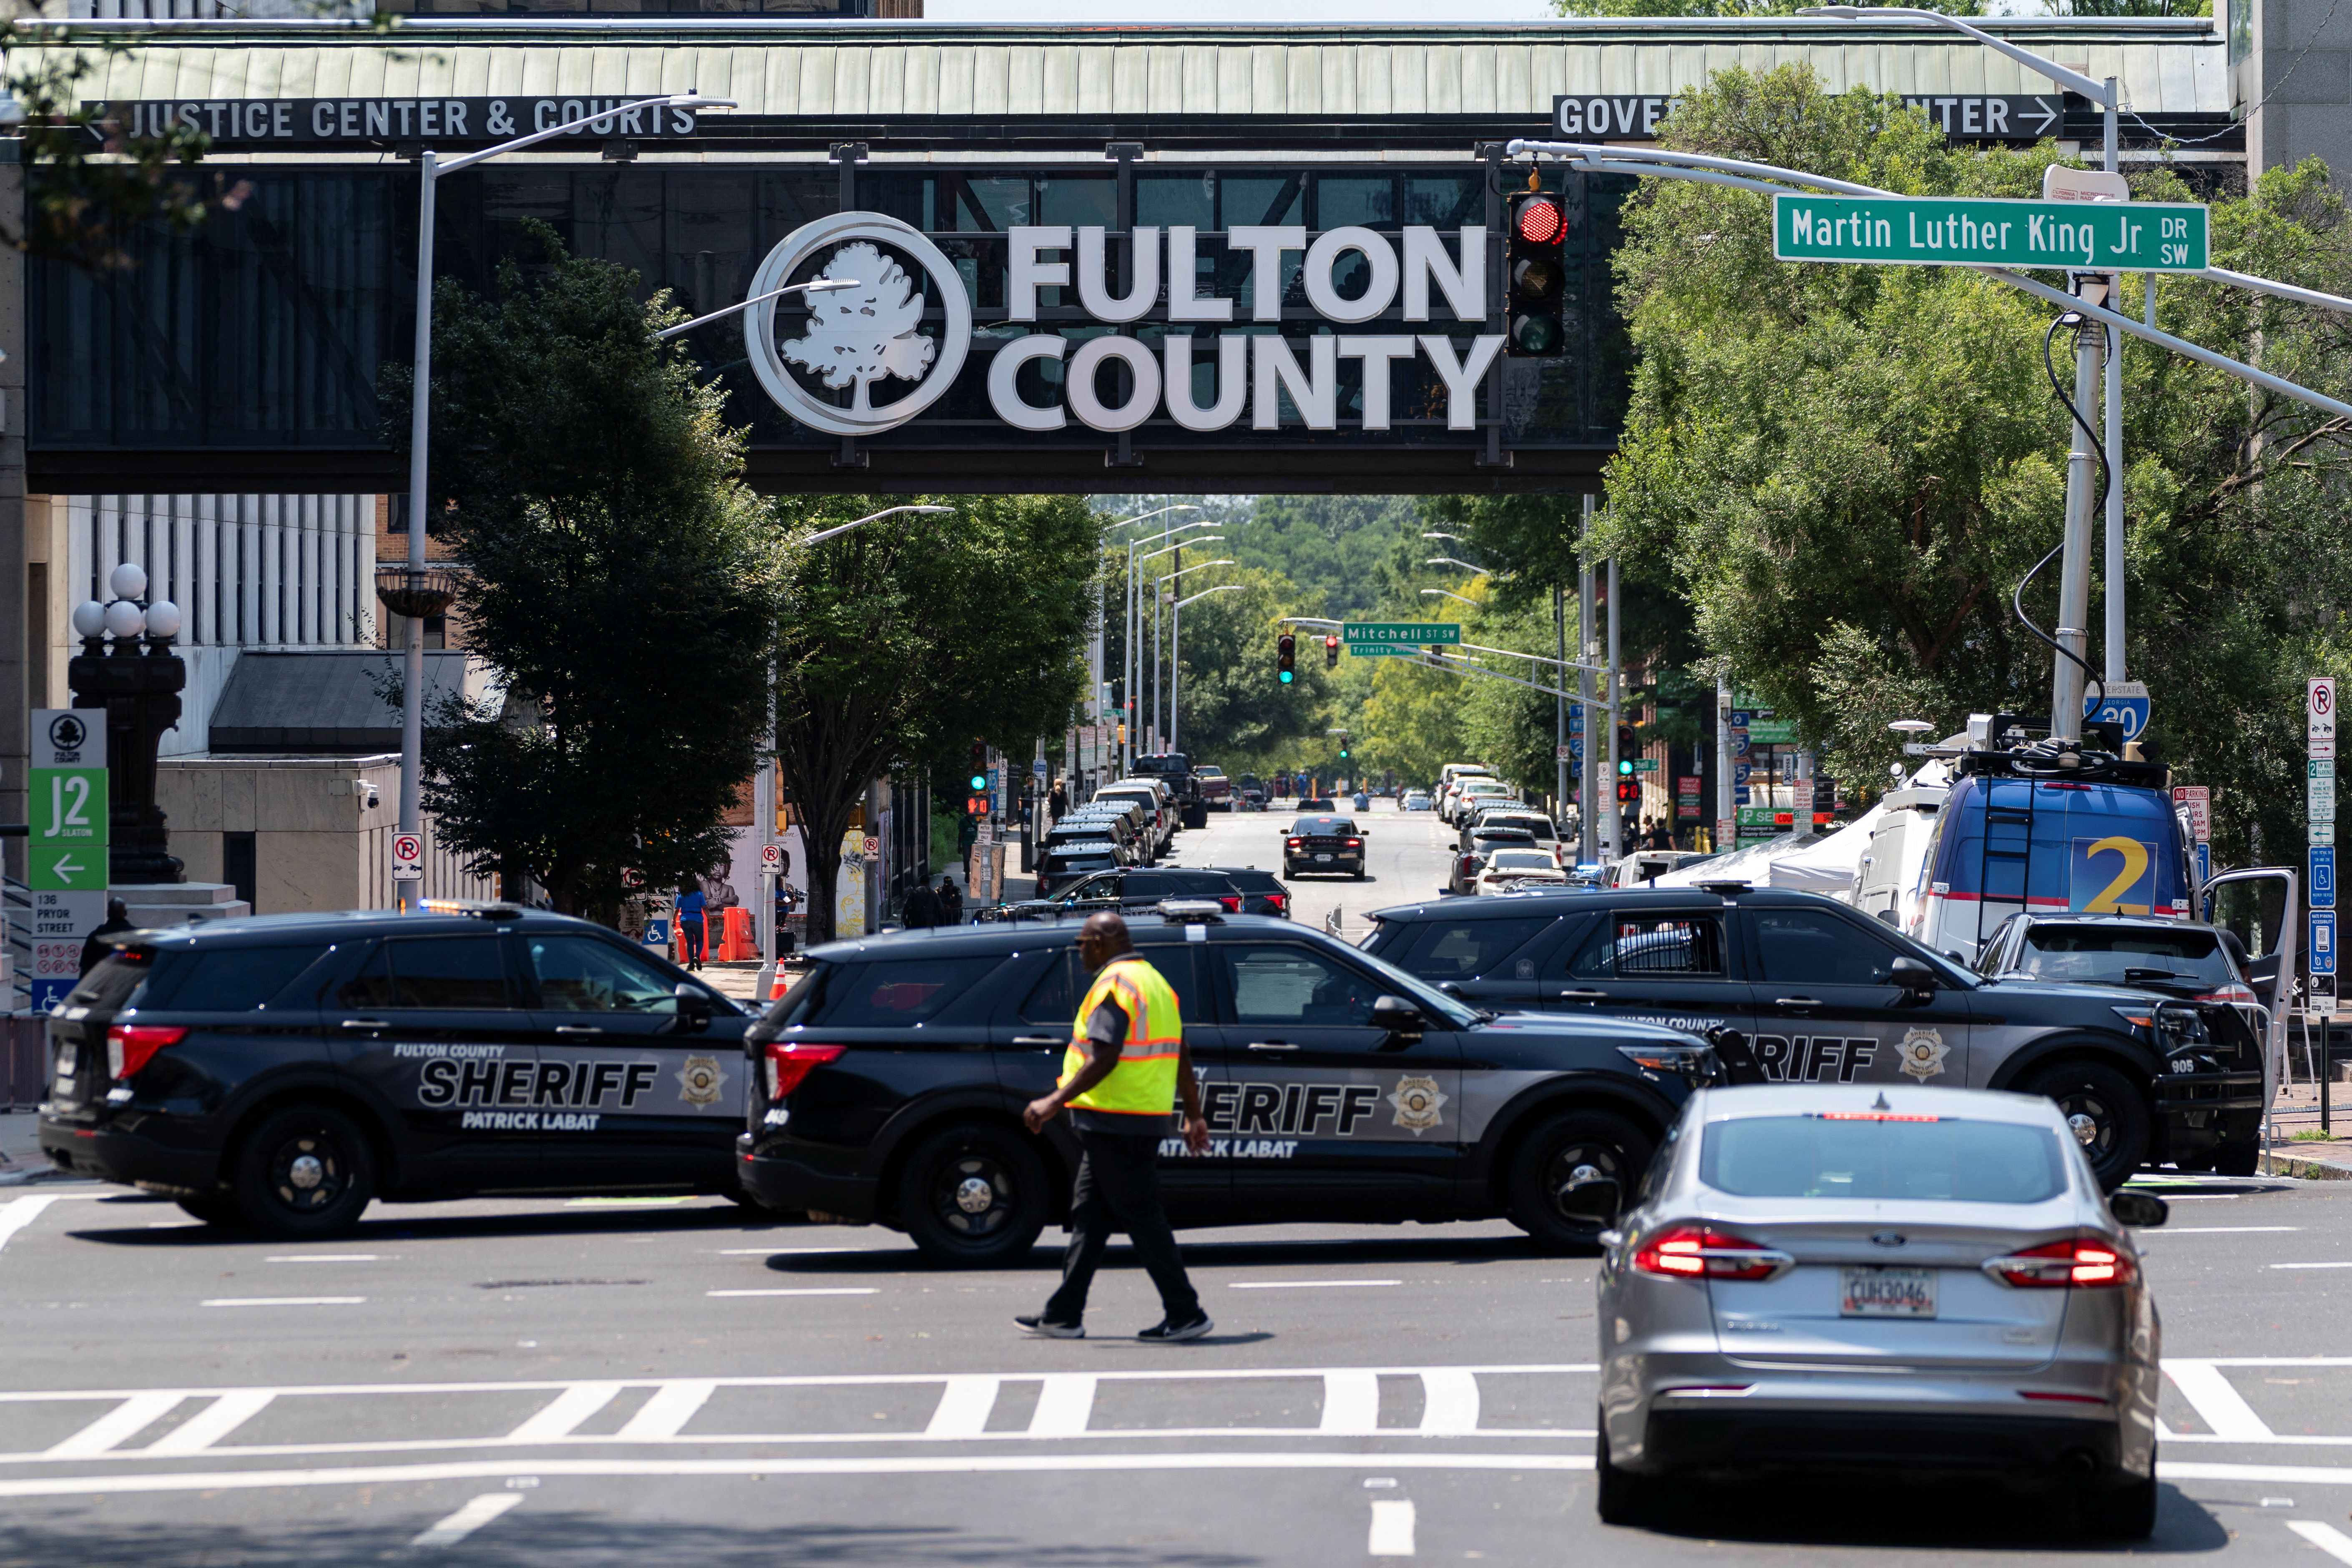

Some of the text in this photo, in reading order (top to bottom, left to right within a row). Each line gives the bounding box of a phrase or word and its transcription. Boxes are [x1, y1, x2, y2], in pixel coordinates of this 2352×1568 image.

[129, 100, 694, 139] JUSTICE CENTER & COURTS
[1792, 209, 1892, 247] Martin
[1910, 212, 2012, 250] Luther
[2029, 214, 2095, 265] King
[2161, 218, 2187, 238] DR
[2161, 244, 2189, 265] SW
[1008, 226, 1486, 322] FULTON
[988, 334, 1505, 432] COUNTY
[1348, 628, 1455, 639] Mitchell ST SW
[2310, 763, 2316, 776] 2
[2186, 789, 2206, 799] PARKING
[44, 776, 89, 837] J2
[2083, 837, 2150, 915] 2
[38, 895, 57, 905] 136
[37, 909, 70, 918] PRYOR
[37, 923, 74, 933] STREET
[393, 1044, 505, 1058] FULTON COUNTY
[1922, 1036, 1937, 1047] COUNTY
[2171, 1059, 2194, 1073] 905
[418, 1058, 660, 1109] SHERIFF
[462, 1111, 600, 1131] PATRICK LABAT
[1232, 1139, 1298, 1159] LABAT
